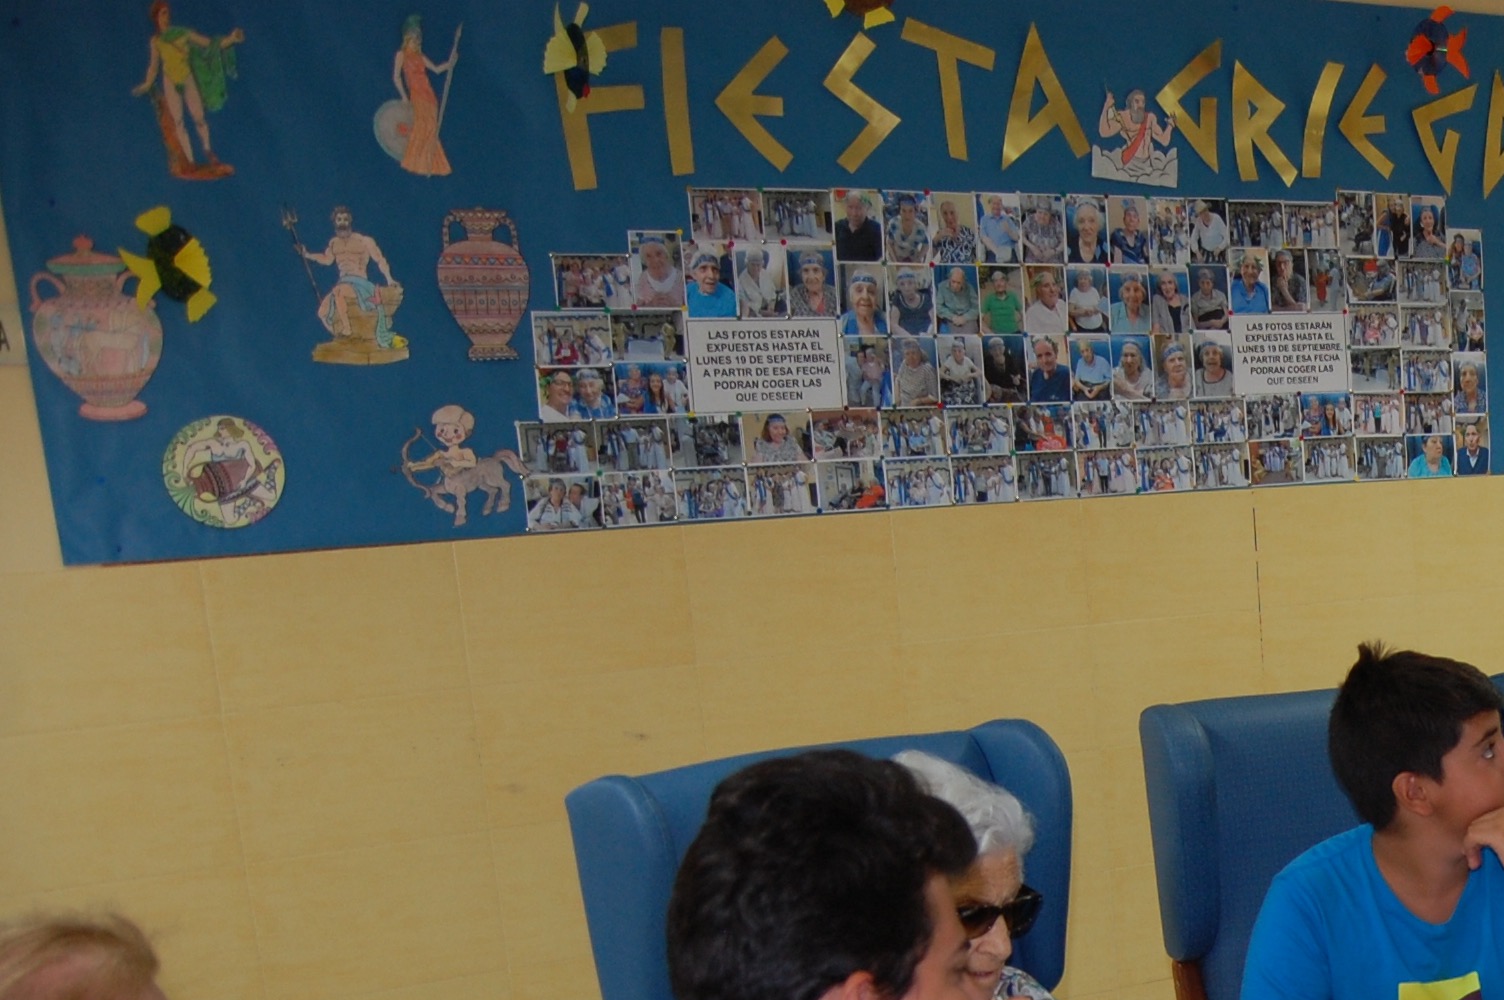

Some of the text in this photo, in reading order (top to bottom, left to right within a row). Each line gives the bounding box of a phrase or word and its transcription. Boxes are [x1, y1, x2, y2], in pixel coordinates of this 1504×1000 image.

[550, 20, 1092, 191] FIESTA
[1247, 321, 1332, 331] LAS FOTOS ESTARÁN
[708, 328, 819, 339] LAS FOTOS ESTARÁN
[1246, 334, 1294, 342] EXPUESTAS
[1297, 333, 1323, 341] HASTA
[707, 342, 823, 352] EXPUESTAS HASTA EL
[1237, 345, 1265, 353] LUNES
[1279, 344, 1289, 352] DE
[696, 356, 731, 365] LUNES
[736, 356, 746, 364] 19
[750, 355, 763, 364] DE
[1243, 356, 1248, 364] A
[1283, 355, 1293, 363] DE
[703, 366, 830, 377] A PARTIR DE ESA FECHA
[1251, 367, 1285, 375] PODRAN
[715, 379, 821, 390] PODRAN COGER LAS
[1267, 377, 1284, 385] QUE
[736, 391, 802, 401] QUE DESEEN
